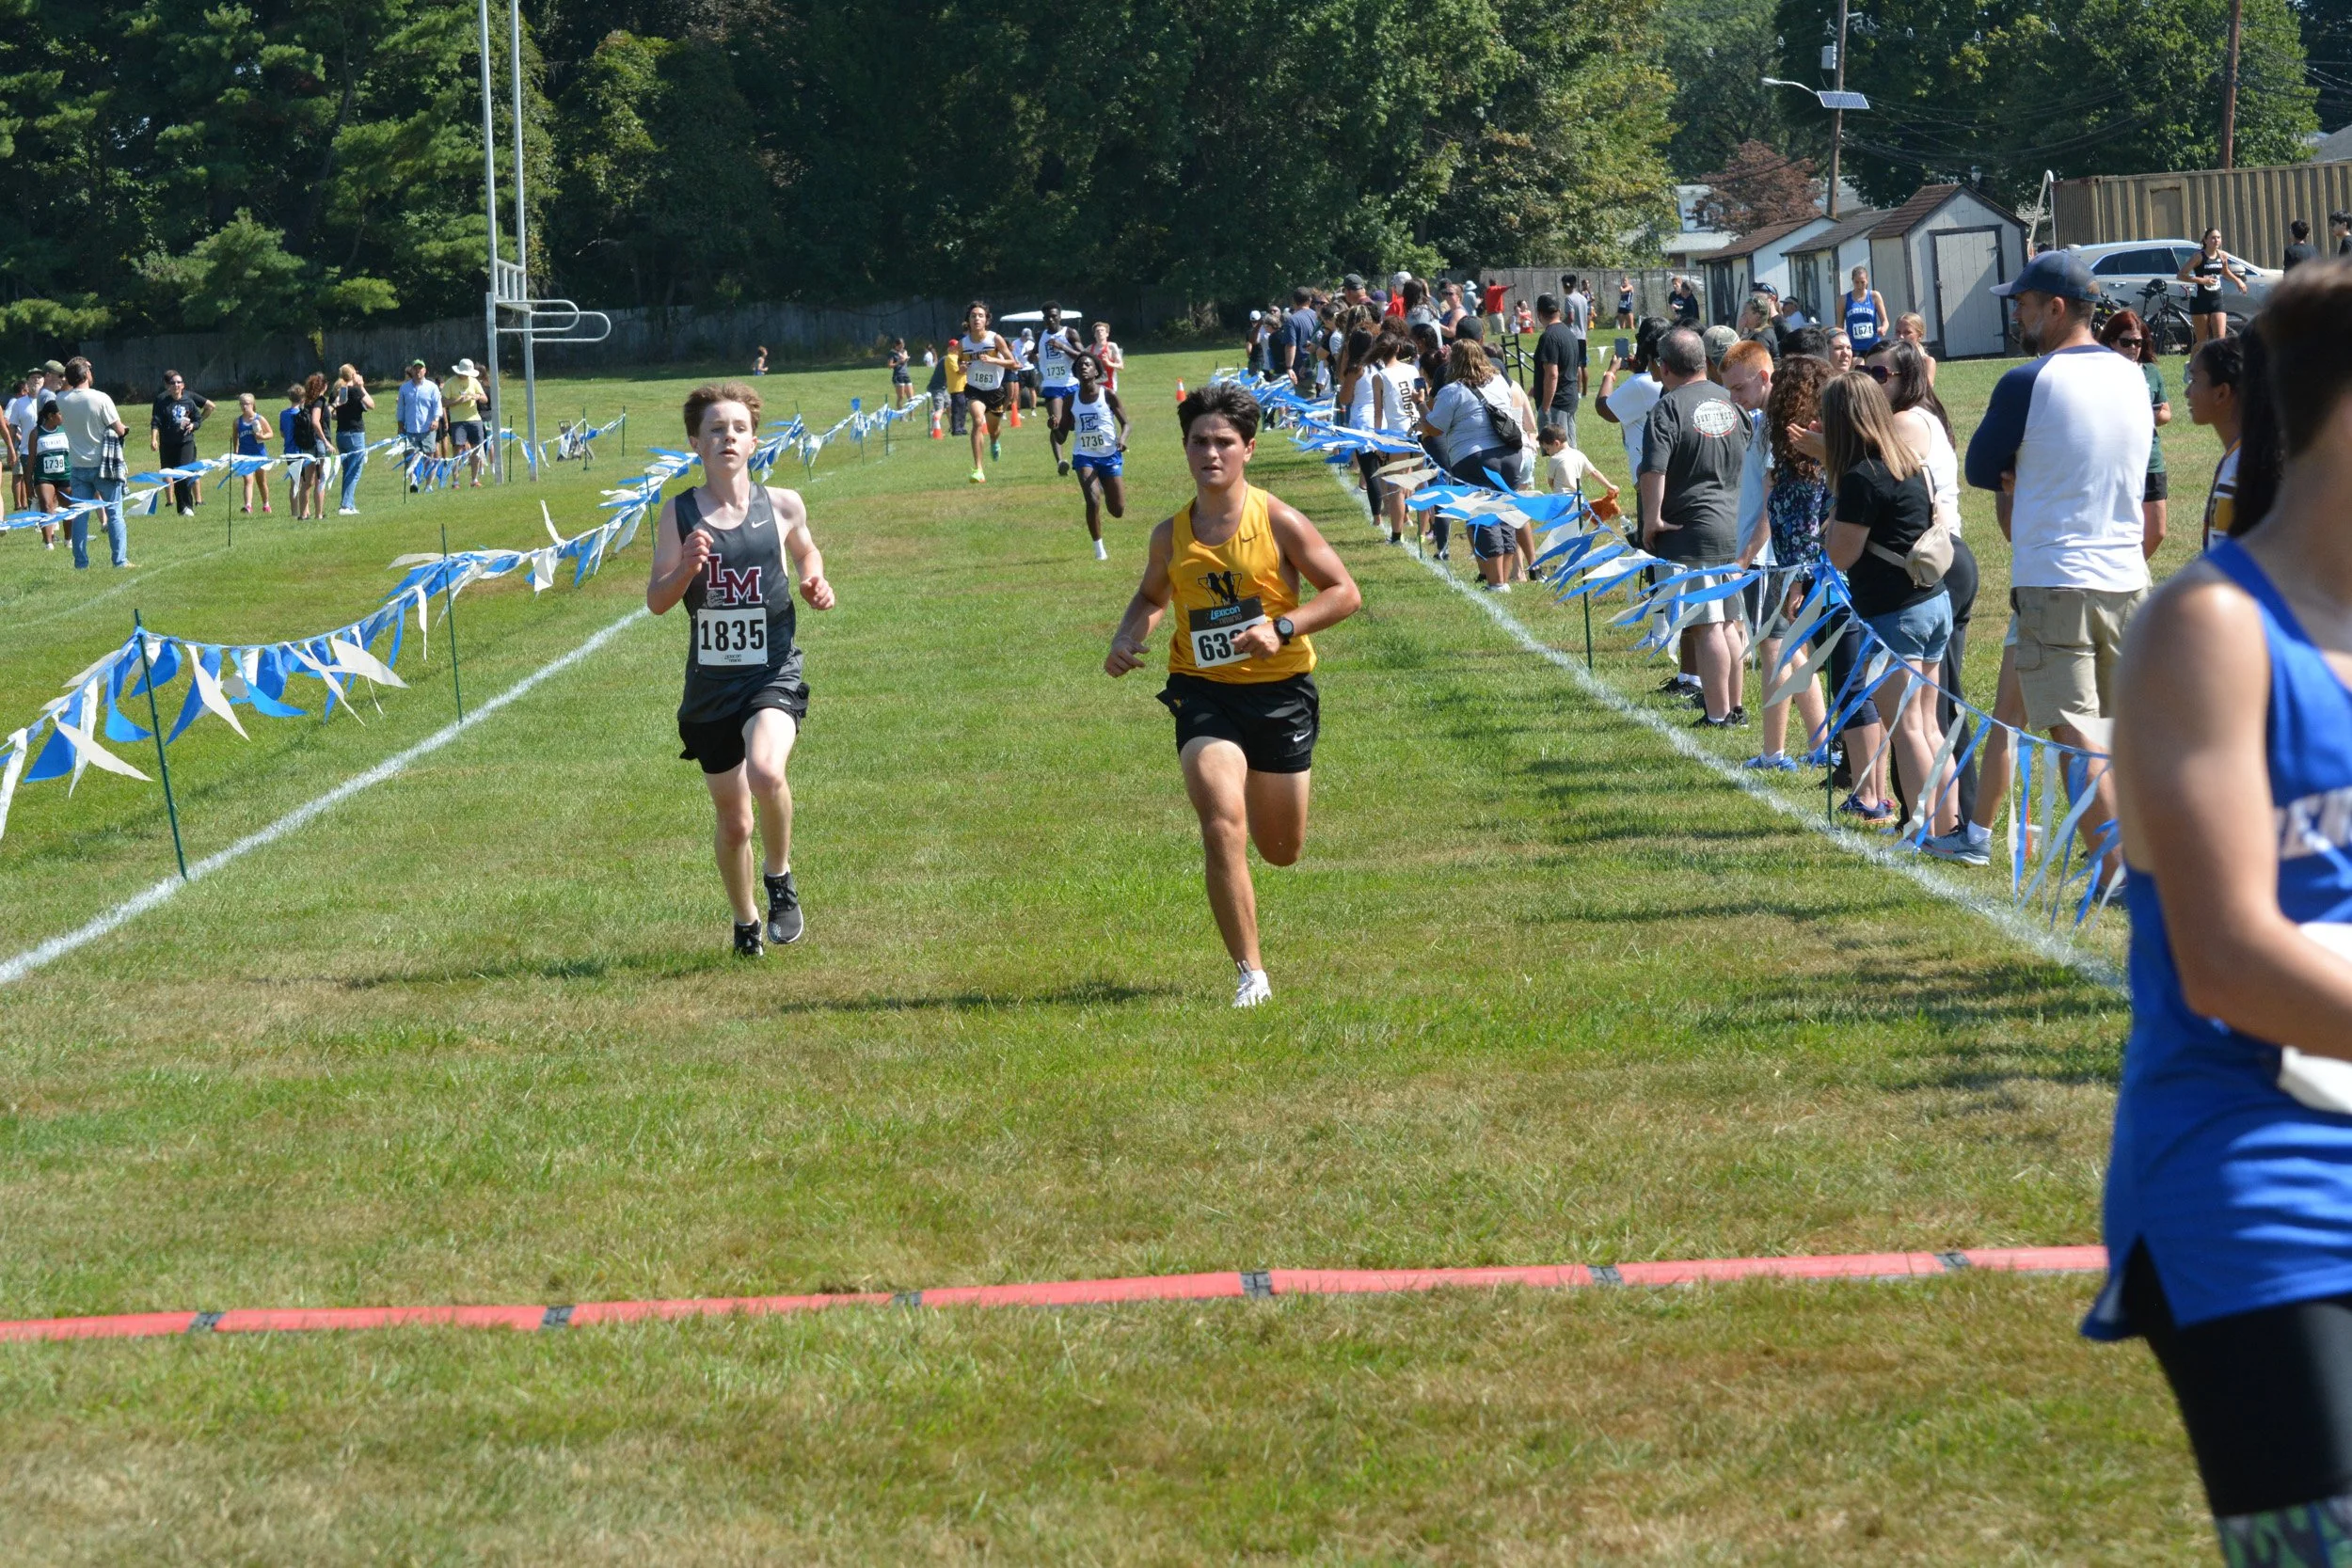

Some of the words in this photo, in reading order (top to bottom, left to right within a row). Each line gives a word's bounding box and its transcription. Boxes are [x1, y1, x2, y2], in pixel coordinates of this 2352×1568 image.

[1047, 366, 1065, 376] 1735
[975, 373, 993, 384] 1863
[1079, 413, 1099, 433] E
[1081, 435, 1104, 447] 1736
[44, 458, 64, 469] 1739
[700, 619, 765, 651] 1835
